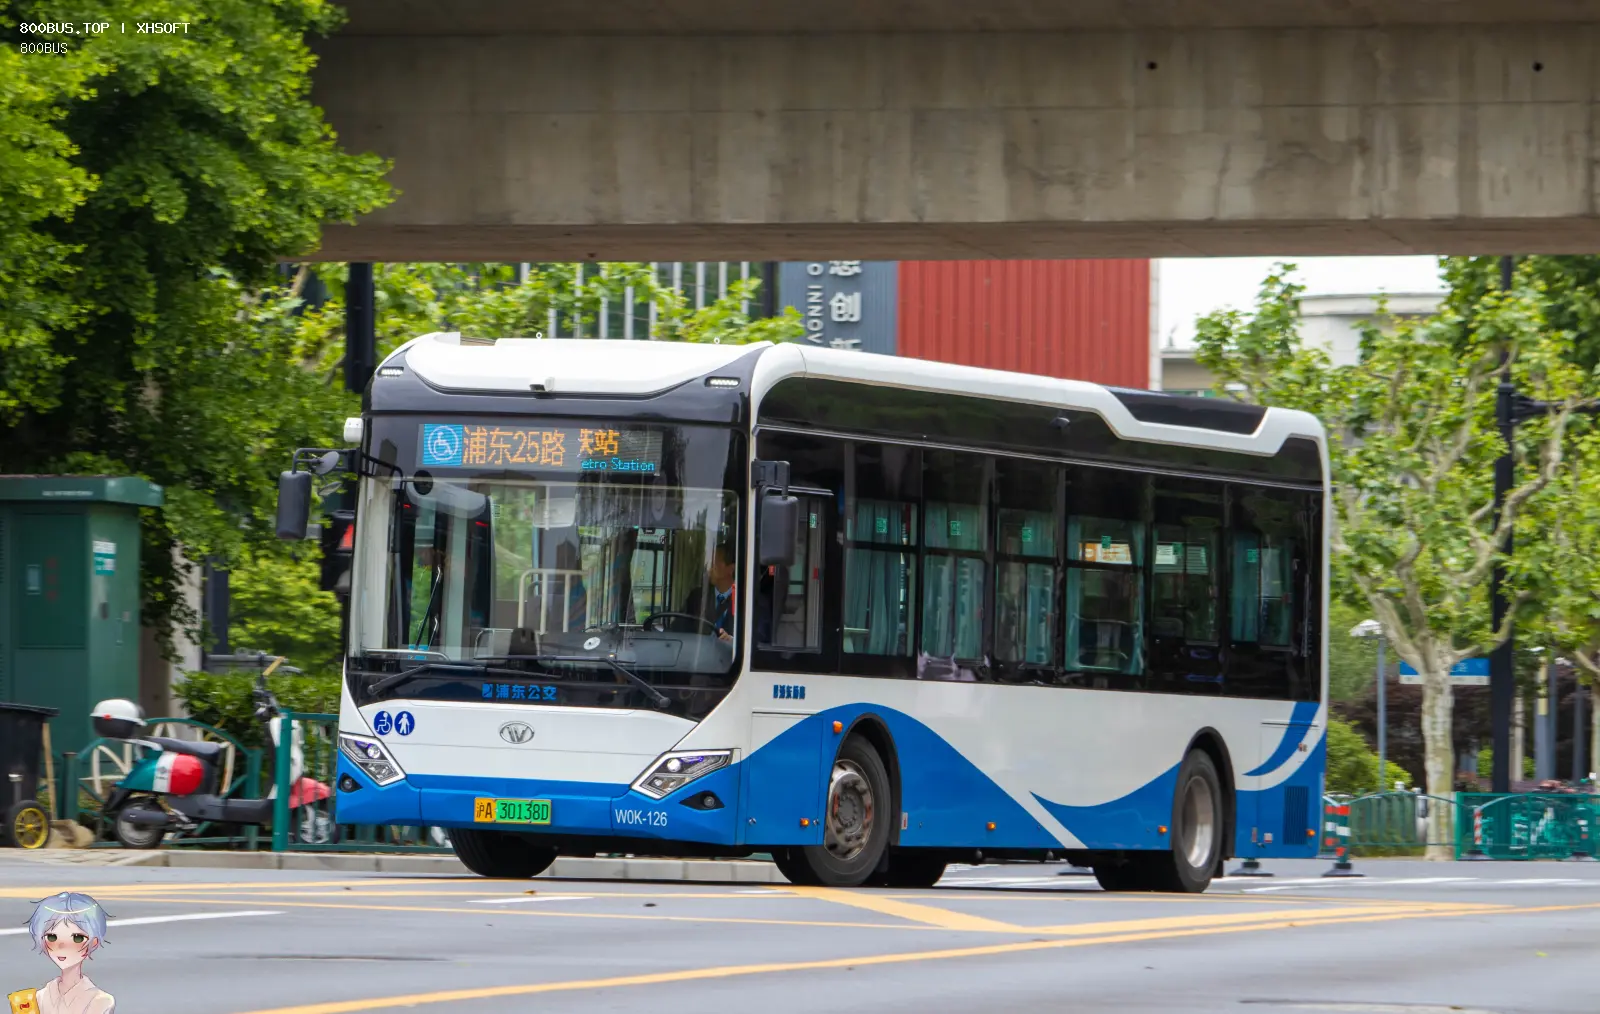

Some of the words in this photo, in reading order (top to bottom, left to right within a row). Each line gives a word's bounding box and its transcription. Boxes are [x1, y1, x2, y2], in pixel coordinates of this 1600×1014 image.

[463, 426, 566, 467] 浦东25路
[611, 457, 656, 472] Station
[495, 684, 558, 700] 浦东公交
